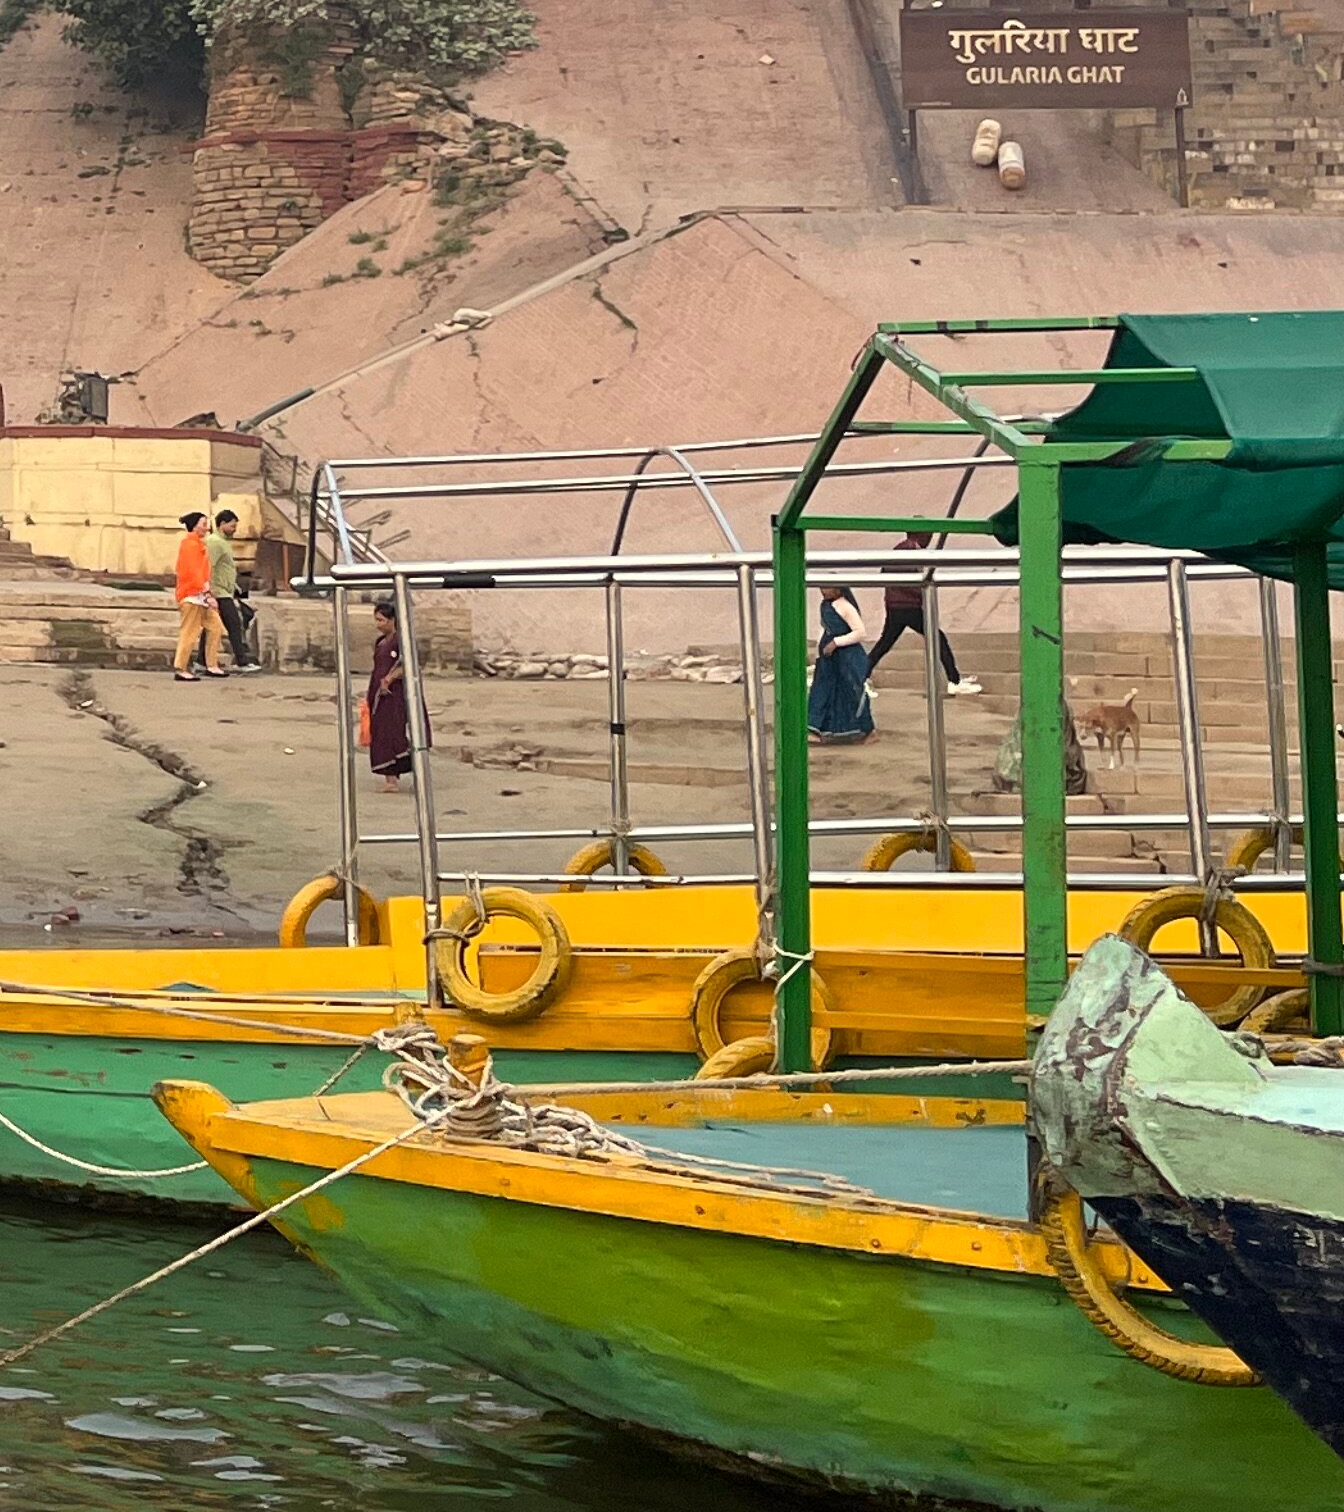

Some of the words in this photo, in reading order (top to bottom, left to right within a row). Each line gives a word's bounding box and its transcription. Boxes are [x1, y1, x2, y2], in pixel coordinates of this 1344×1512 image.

[947, 19, 1070, 64] गुलरिया
[1078, 28, 1140, 54] घाट
[965, 66, 1062, 84] GULARIA
[1067, 66, 1126, 84] GHAT
